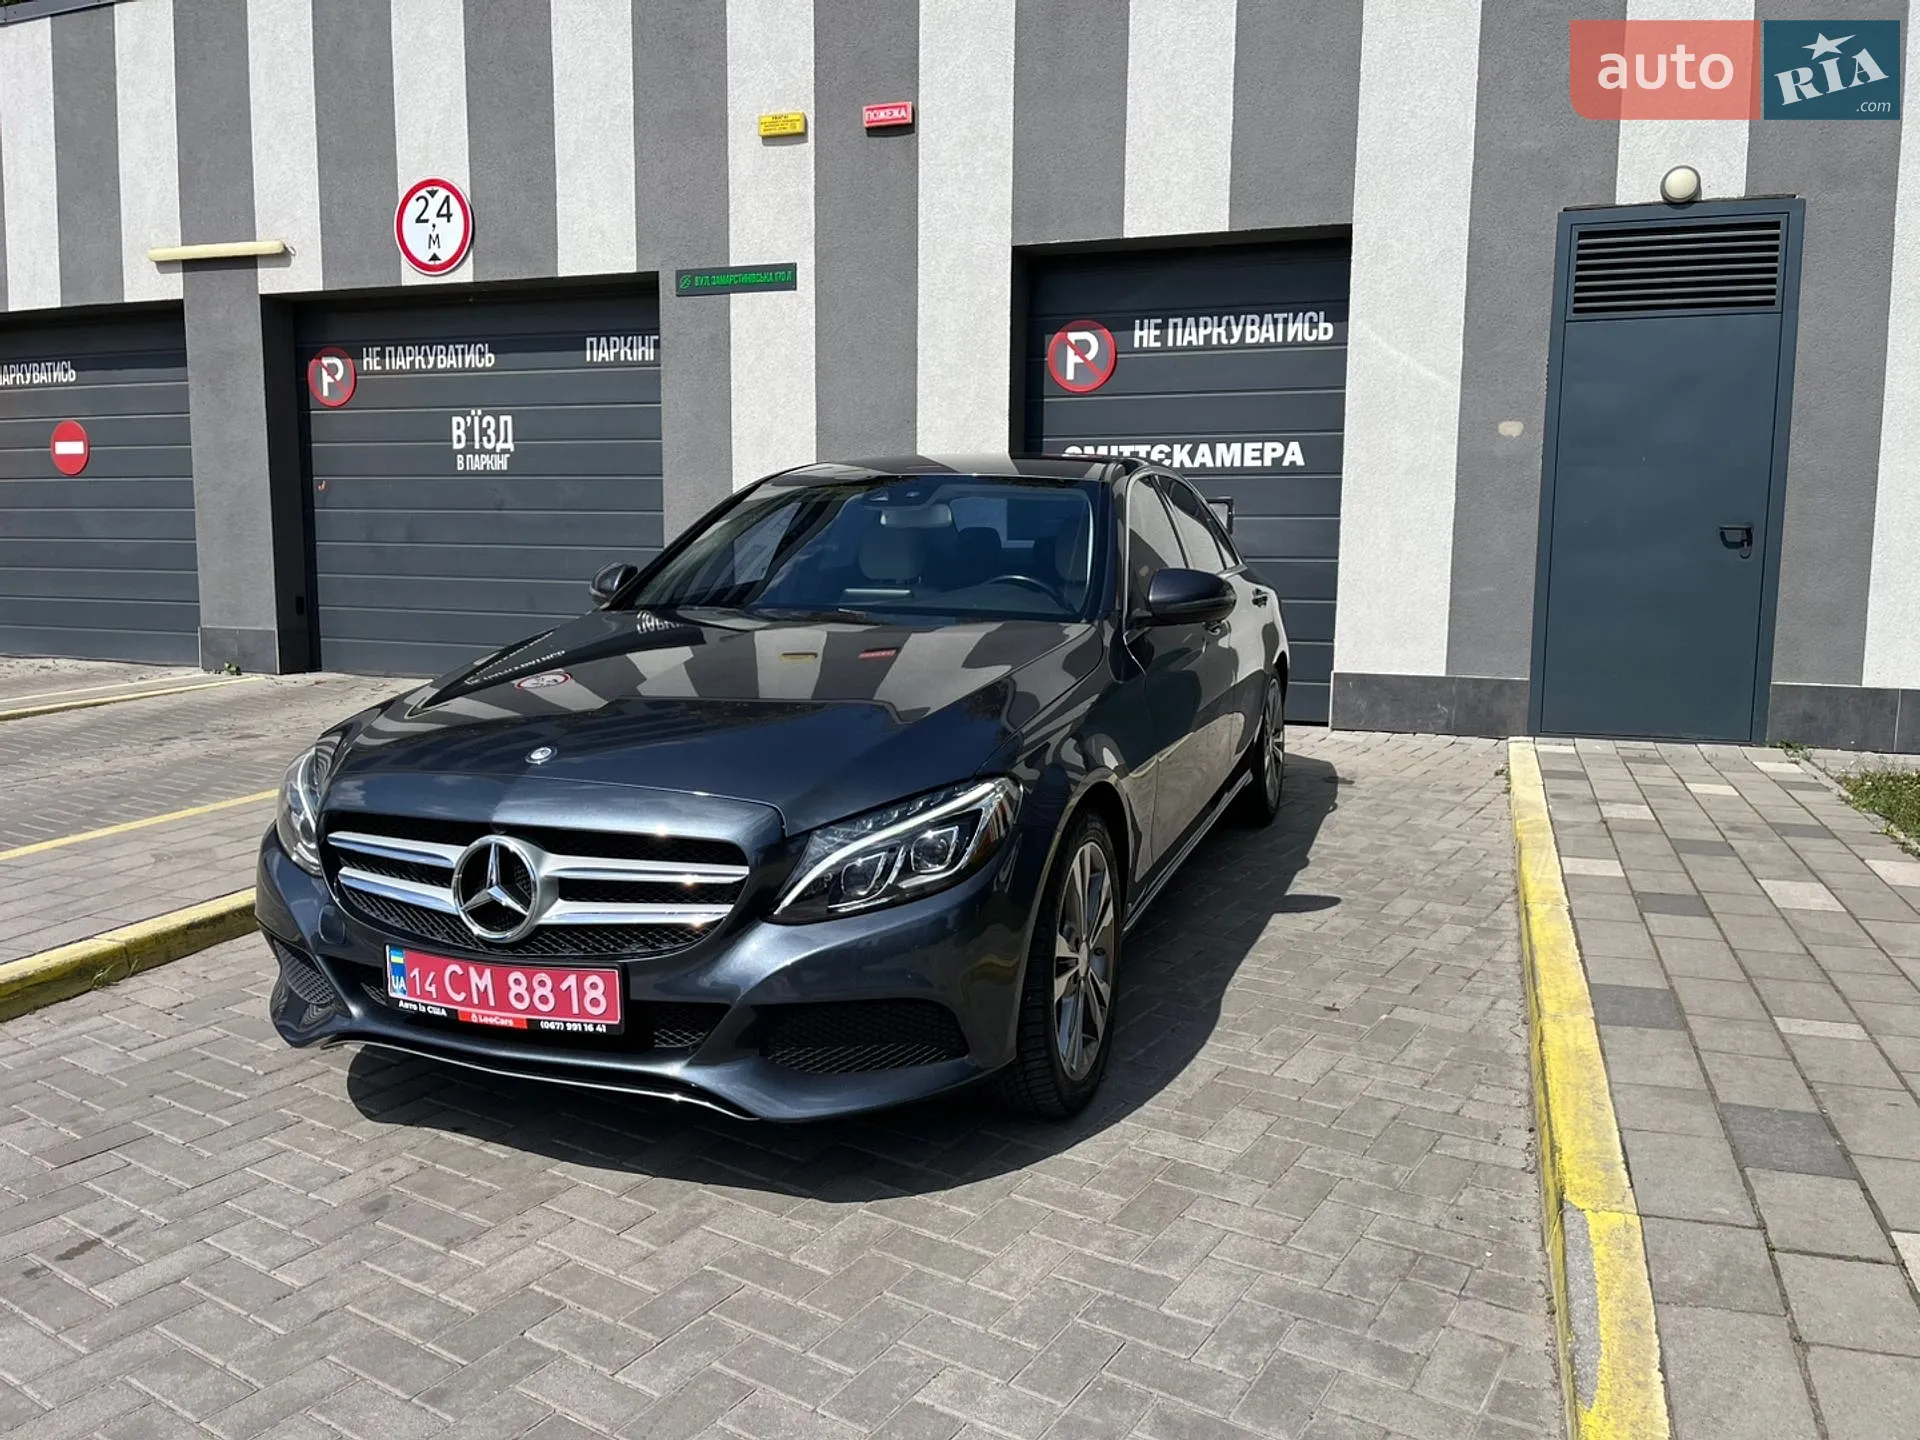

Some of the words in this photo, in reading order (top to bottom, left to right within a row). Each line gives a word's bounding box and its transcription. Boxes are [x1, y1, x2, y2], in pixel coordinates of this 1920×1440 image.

[1133, 318, 1161, 348] НЕ
[1167, 311, 1334, 347] ПАРКУВАТИСЬ
[362, 347, 382, 371] НЕ
[385, 343, 495, 370] ПАРКУВАТИСЬ
[586, 335, 659, 362] ПАРКІНГ
[452, 409, 515, 453] В'ЇЗД
[457, 454, 464, 471] В
[466, 453, 511, 471] ПАРКІНГ
[391, 975, 407, 991] UA
[410, 967, 437, 999] 14
[443, 964, 496, 1007] CM
[507, 971, 608, 1016] 8818
